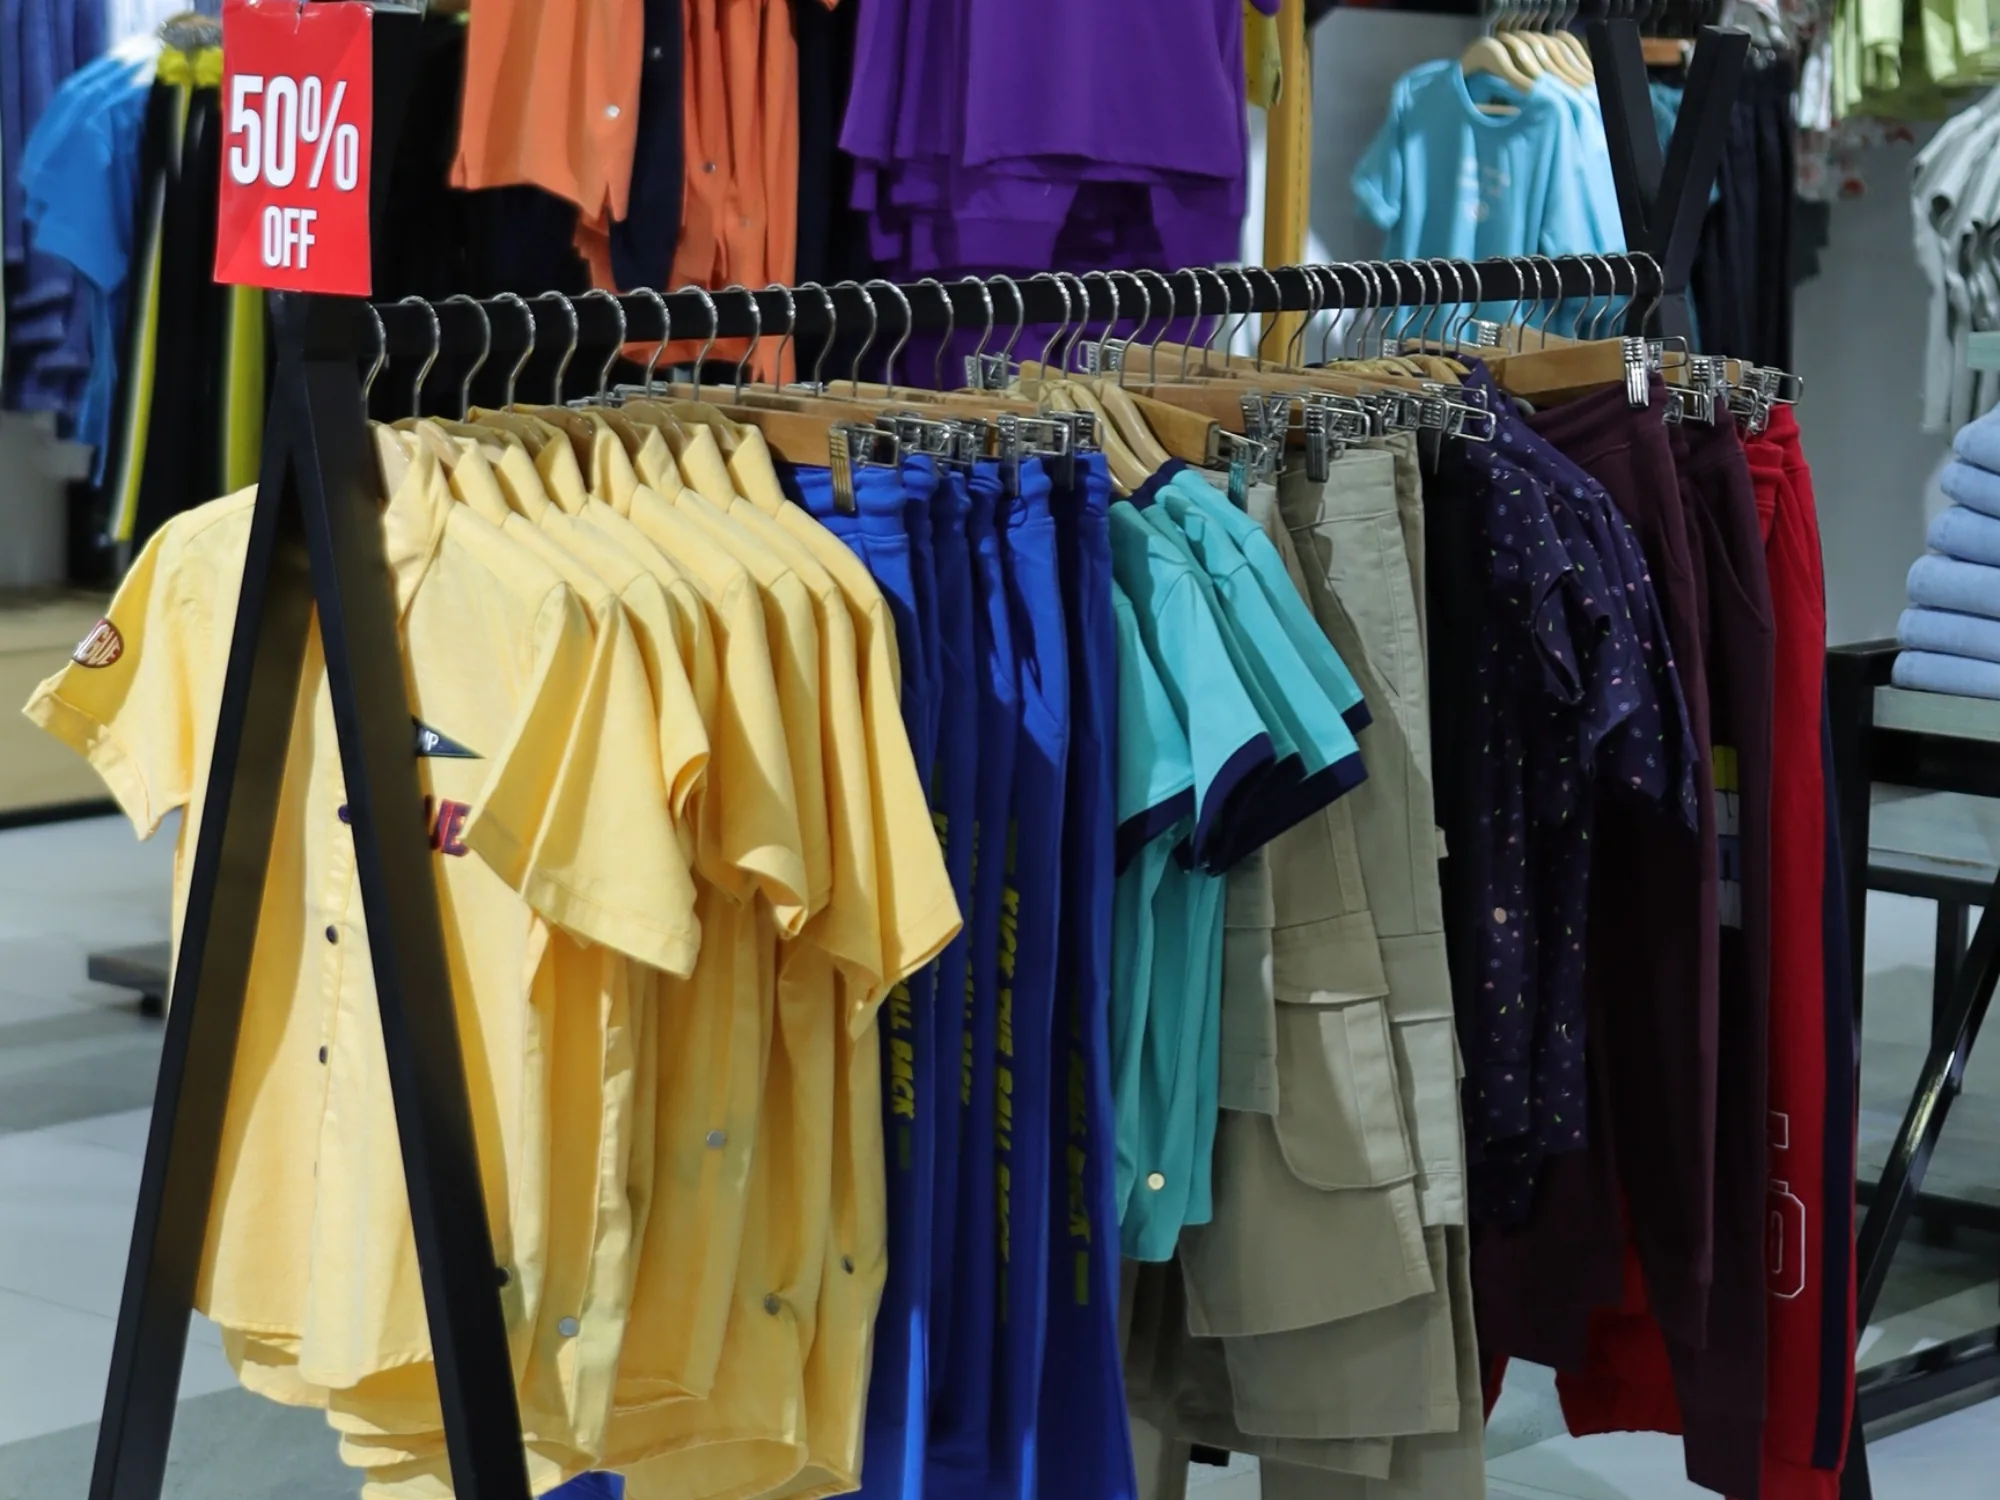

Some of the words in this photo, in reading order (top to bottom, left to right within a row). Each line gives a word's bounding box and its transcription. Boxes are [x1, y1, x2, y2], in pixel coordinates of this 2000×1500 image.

[230, 74, 359, 190] 50%
[263, 205, 317, 269] OFF
[889, 977, 913, 1031] ALL
[891, 1037, 915, 1119] BACK
